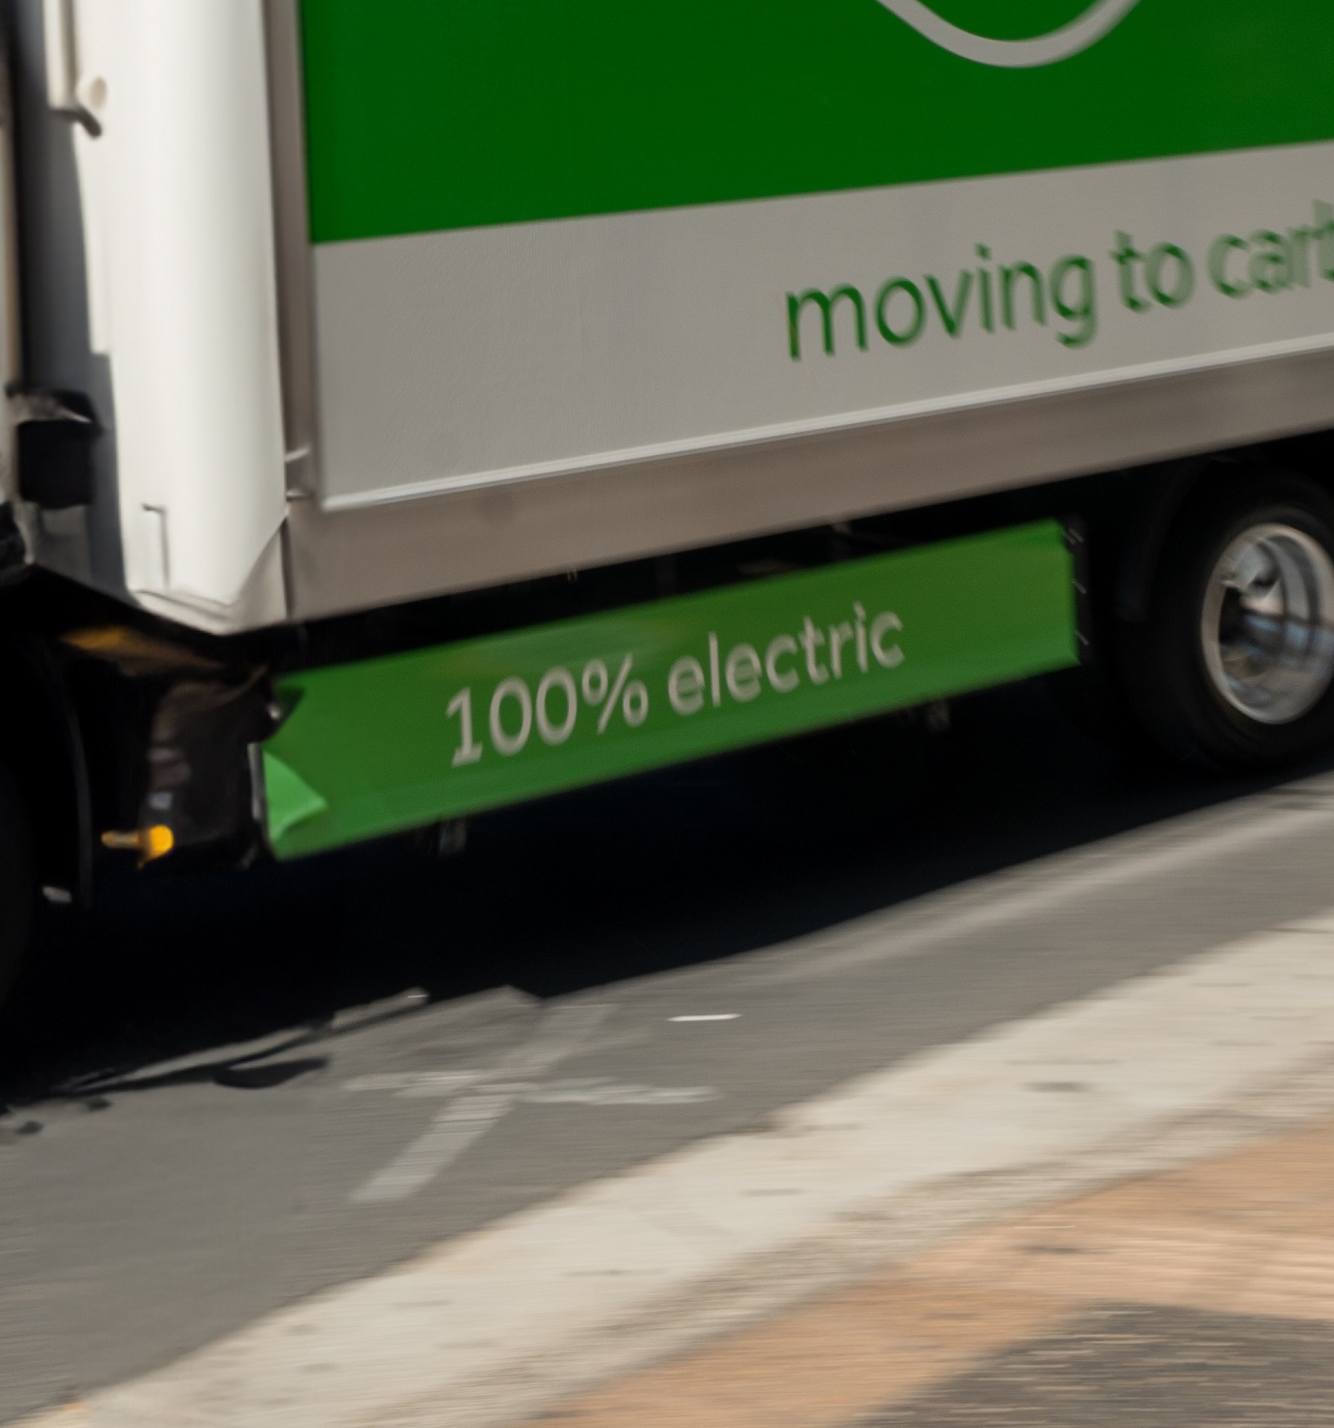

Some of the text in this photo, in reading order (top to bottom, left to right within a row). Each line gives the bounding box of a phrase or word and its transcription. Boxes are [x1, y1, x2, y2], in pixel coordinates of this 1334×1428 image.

[784, 241, 1097, 363] moving
[1108, 229, 1196, 315] to
[443, 601, 906, 768] 100% electric
